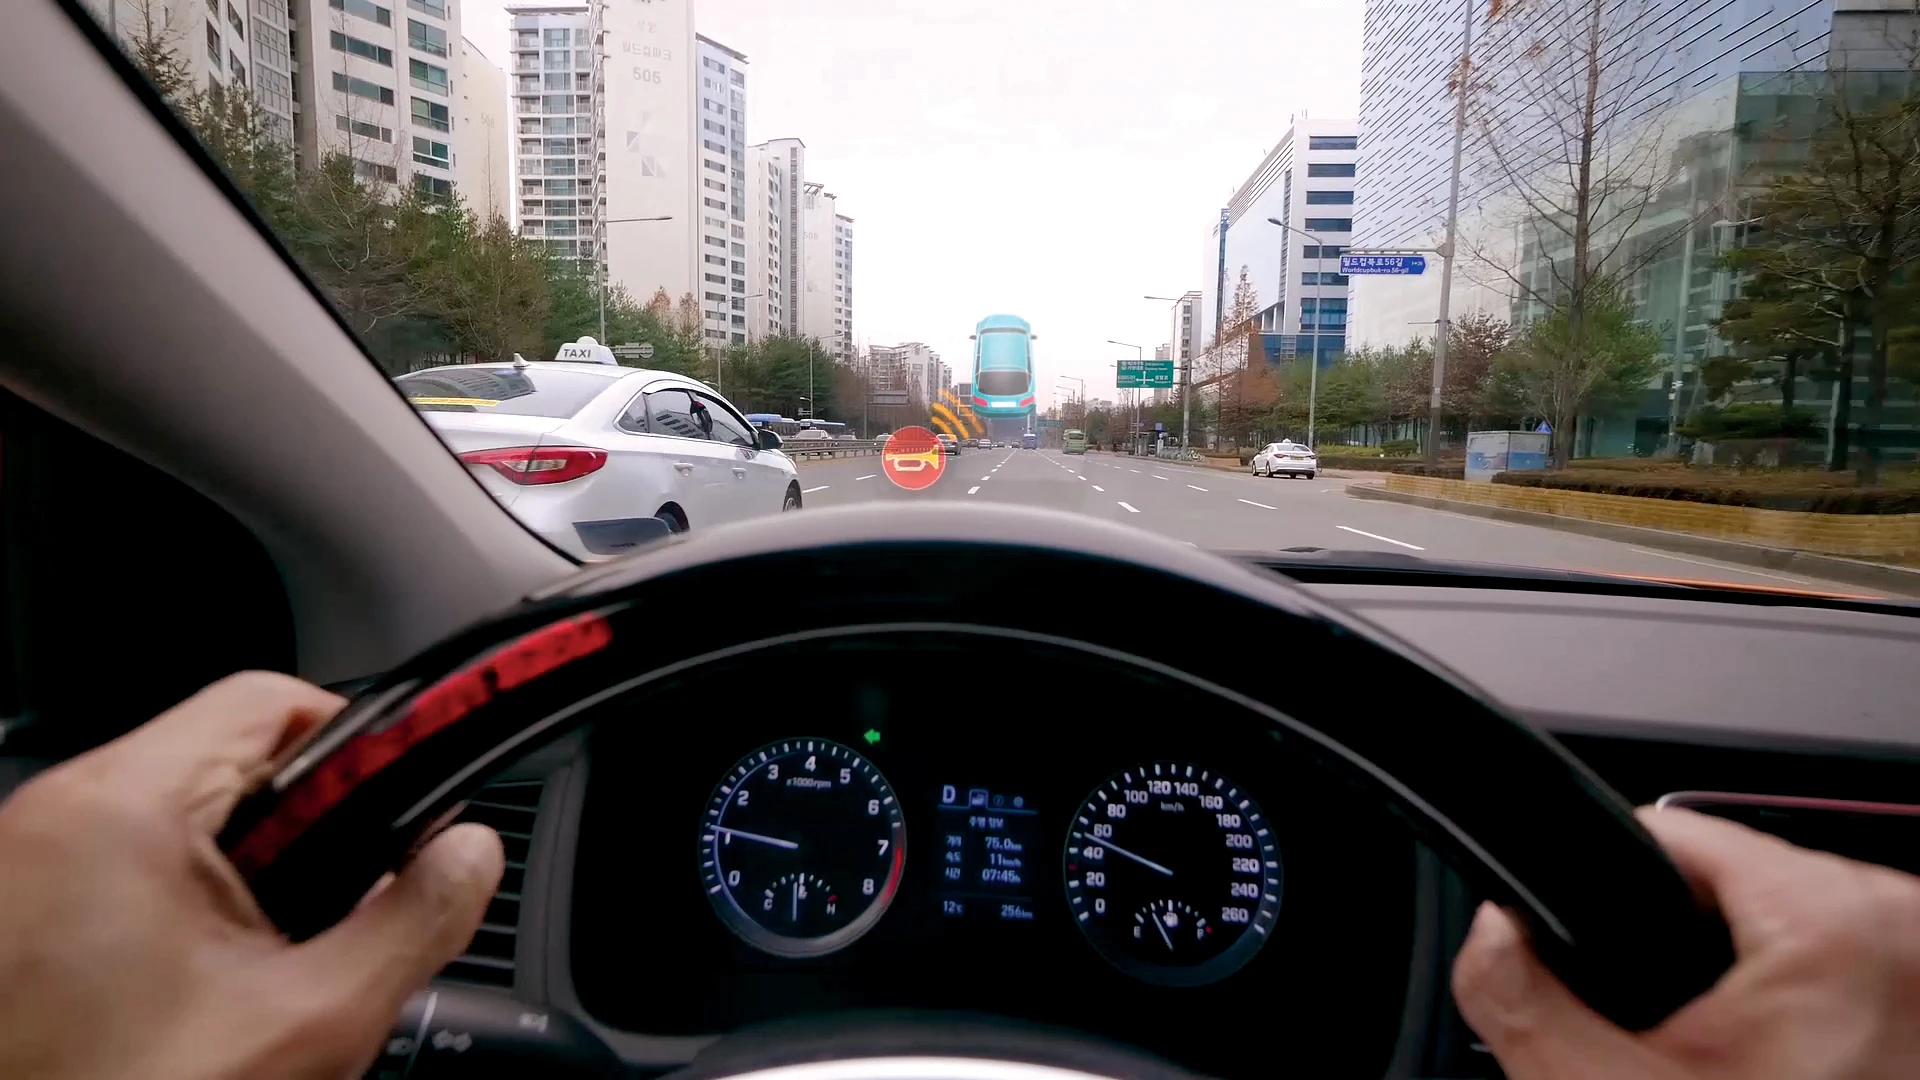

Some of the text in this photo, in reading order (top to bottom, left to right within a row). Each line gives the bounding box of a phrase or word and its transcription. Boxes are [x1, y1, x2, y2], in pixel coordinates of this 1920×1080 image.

[633, 66, 661, 84] 505
[1342, 257, 1403, 266] 월드컵북로56길
[563, 349, 591, 358] TAXI
[804, 755, 816, 772] 4
[767, 764, 779, 780] 3
[839, 767, 851, 784] 5
[942, 784, 956, 804] D
[1147, 780, 1171, 795] 120
[1174, 781, 1199, 796] 140
[737, 790, 750, 806] 2
[1124, 789, 1148, 804] 100
[1199, 795, 1223, 810] 160
[868, 799, 880, 815] 6
[1107, 803, 1126, 818] 80
[1160, 800, 1185, 812] km/h
[1216, 813, 1241, 828] 180
[724, 831, 731, 845] 1
[1093, 824, 1113, 839] 60
[877, 839, 889, 856] 7
[1225, 833, 1253, 849] 200
[1083, 847, 1104, 860] 40
[1232, 857, 1260, 874] 220
[728, 870, 741, 887] 0
[1086, 871, 1105, 887] 20
[862, 878, 875, 896] 8
[1231, 882, 1259, 899] 240
[1095, 898, 1105, 914] 0
[1221, 906, 1250, 923] 260
[1133, 925, 1142, 939] E
